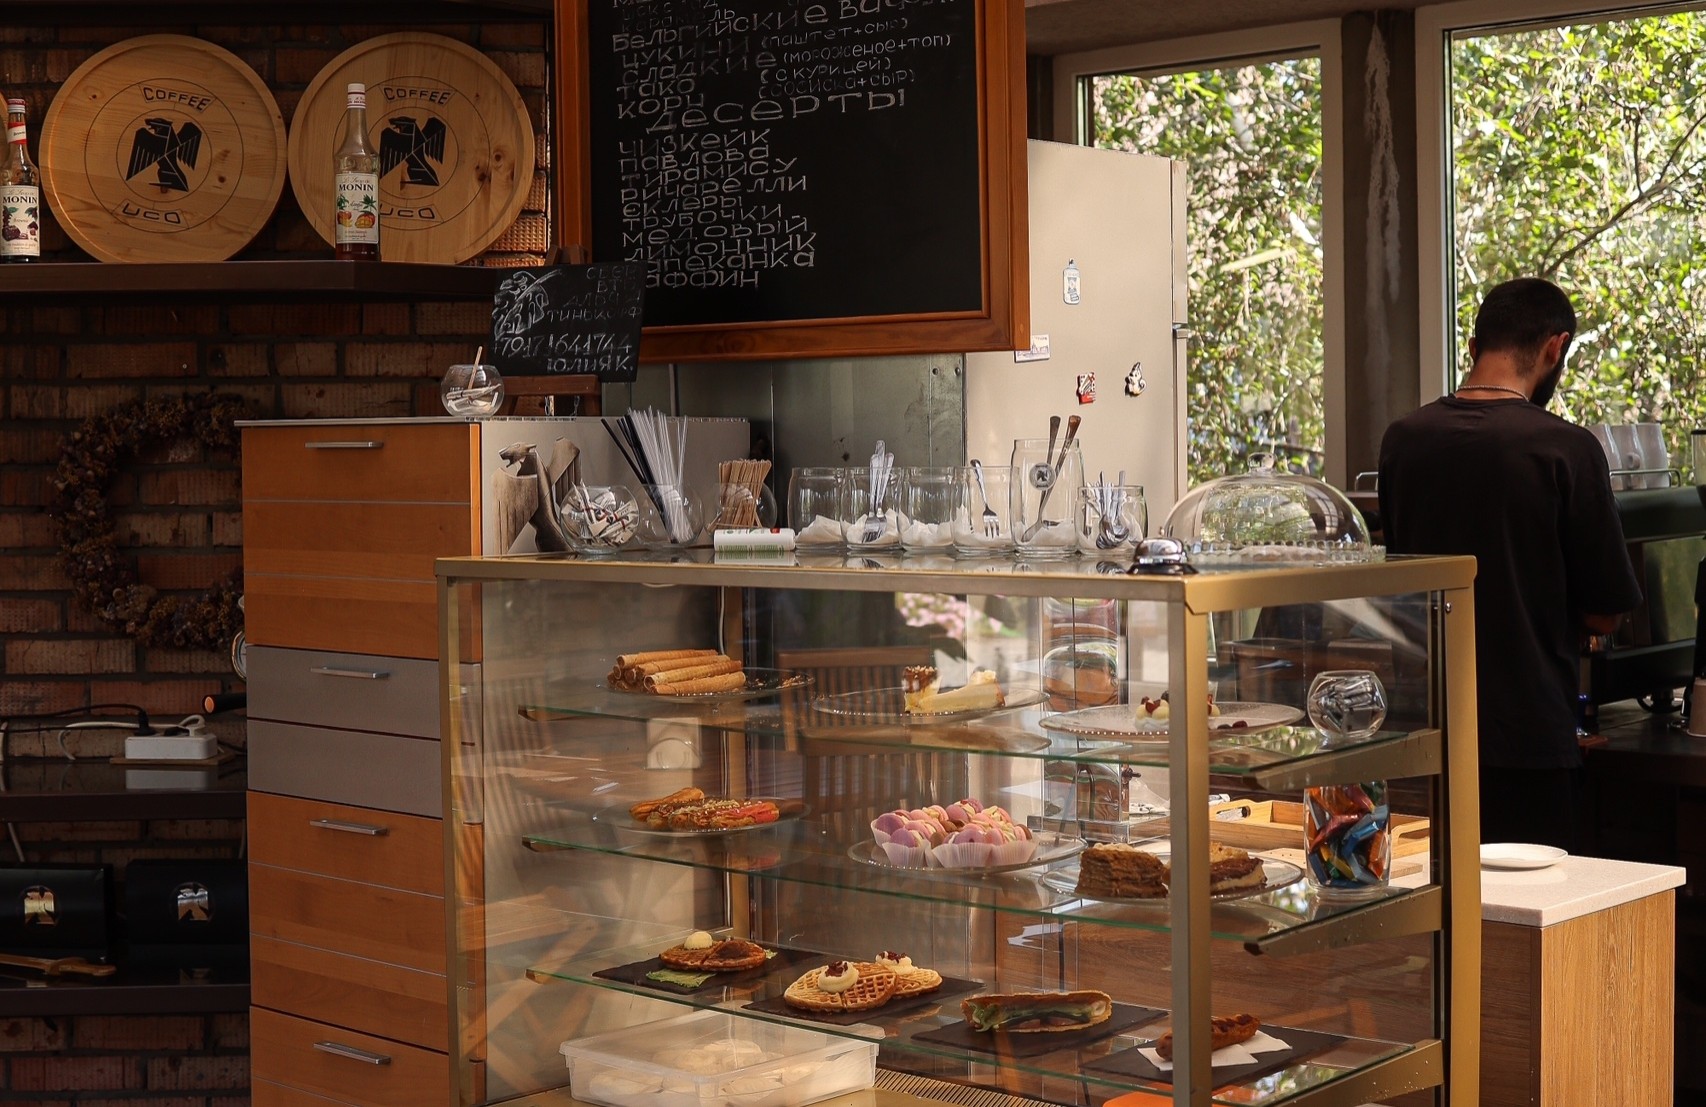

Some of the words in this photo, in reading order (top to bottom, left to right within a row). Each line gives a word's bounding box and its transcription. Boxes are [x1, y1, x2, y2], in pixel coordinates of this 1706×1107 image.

[143, 86, 211, 111] COFFEE
[383, 87, 451, 105] COFFEE
[618, 128, 771, 156] чизкейк
[618, 144, 769, 173] павлова
[621, 157, 798, 188] тирамису
[338, 183, 374, 192] MONIN
[2, 195, 38, 204] MONIN
[122, 202, 181, 225] UCO
[646, 251, 815, 274] апеканка
[646, 270, 760, 289] аффин
